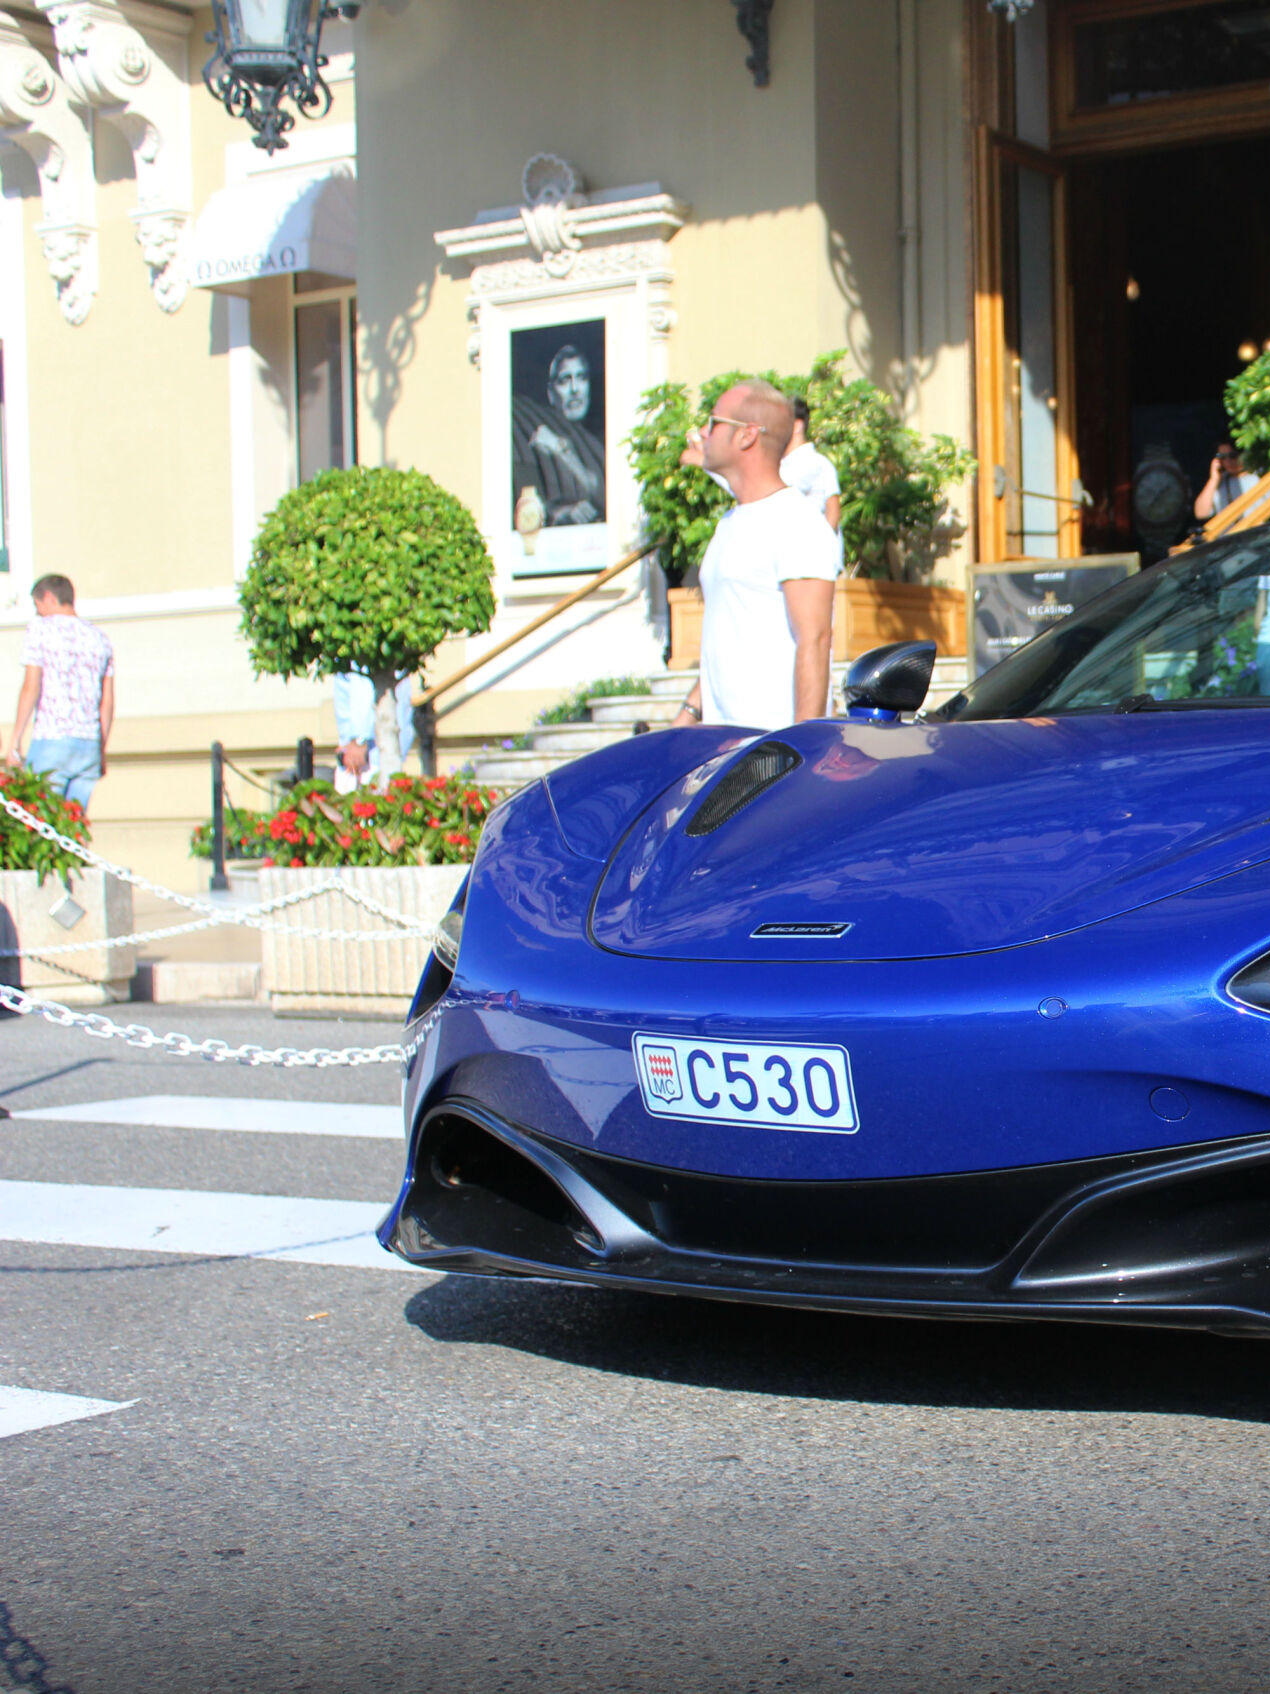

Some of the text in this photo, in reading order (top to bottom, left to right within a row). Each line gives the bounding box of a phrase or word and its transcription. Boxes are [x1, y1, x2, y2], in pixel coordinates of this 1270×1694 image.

[216, 254, 276, 276] OMEGA
[1027, 604, 1073, 616] LE CASINO
[653, 1078, 676, 1095] MC
[687, 1049, 840, 1118] C530
